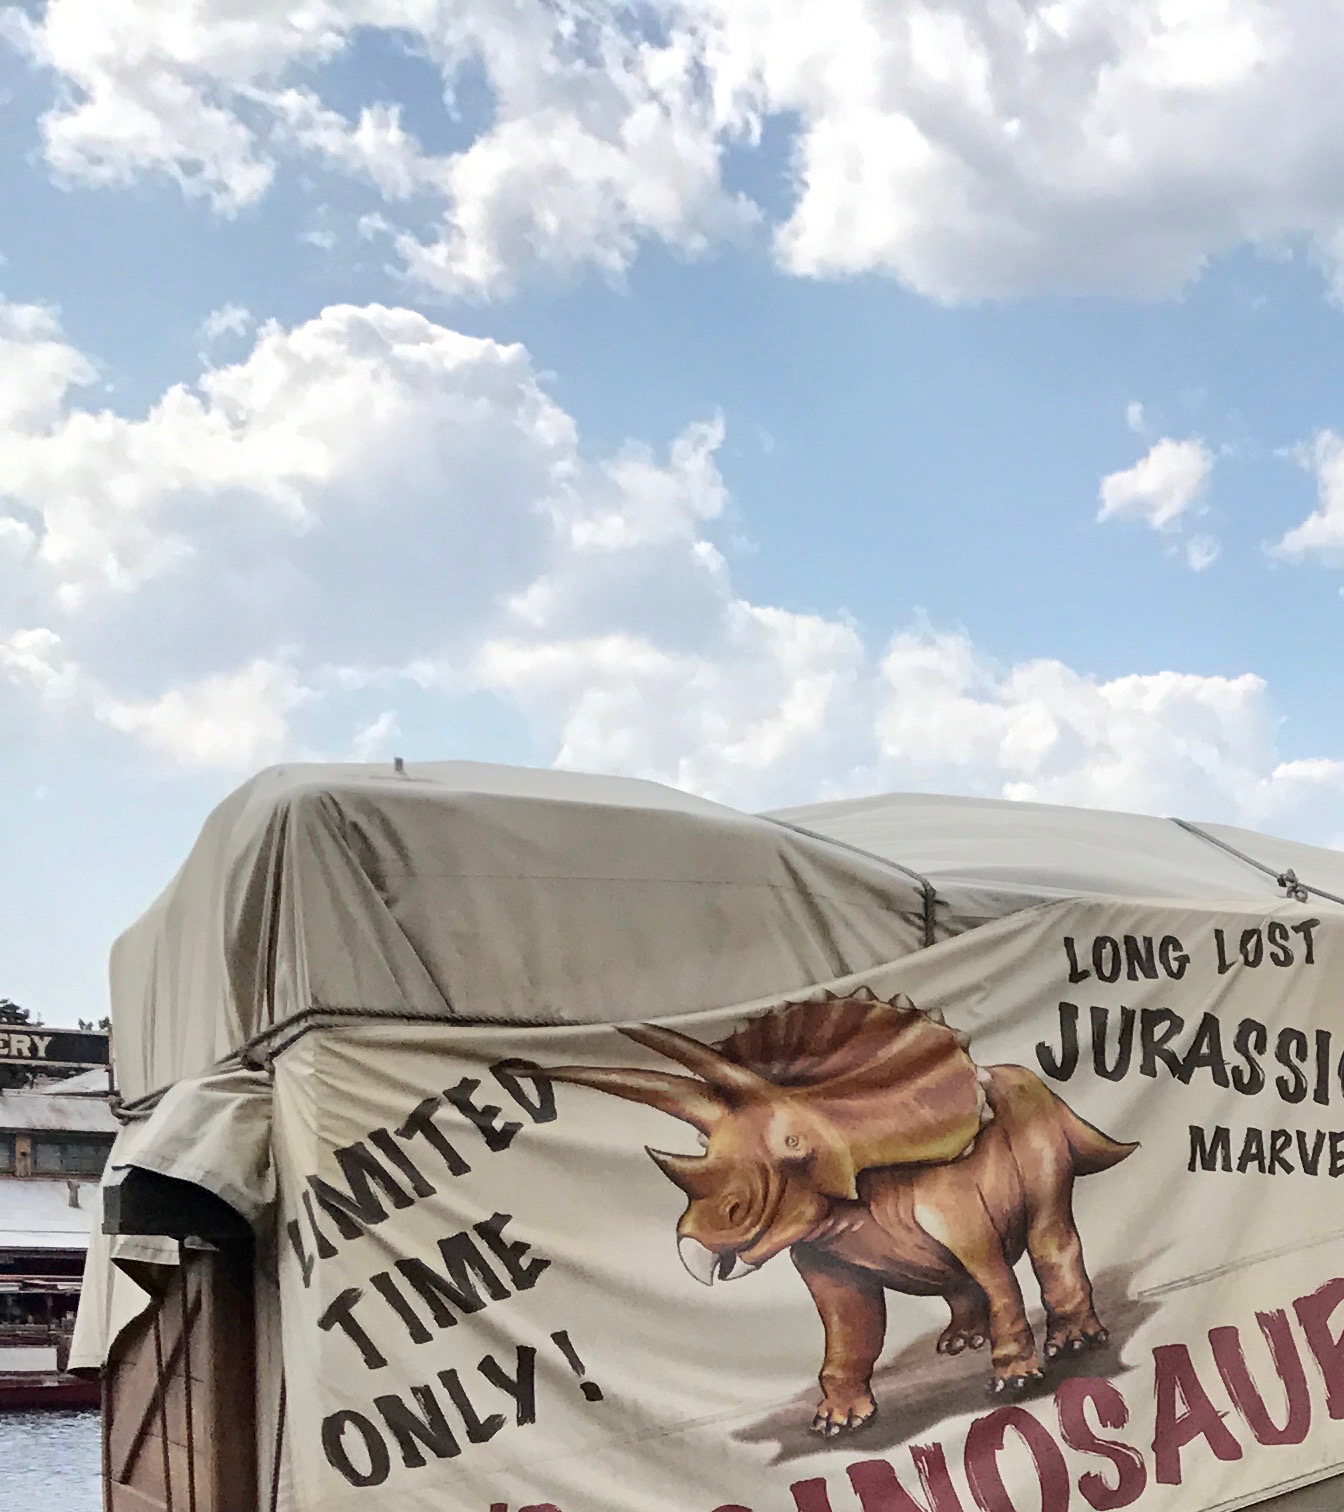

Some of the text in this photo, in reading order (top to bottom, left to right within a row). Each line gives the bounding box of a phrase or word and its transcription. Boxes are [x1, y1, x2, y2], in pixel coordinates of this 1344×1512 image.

[1064, 919, 1320, 984] LONG LOST
[288, 1058, 558, 1288] LIMITED
[318, 1212, 551, 1370] TIME
[321, 1330, 603, 1487] ONLY!
